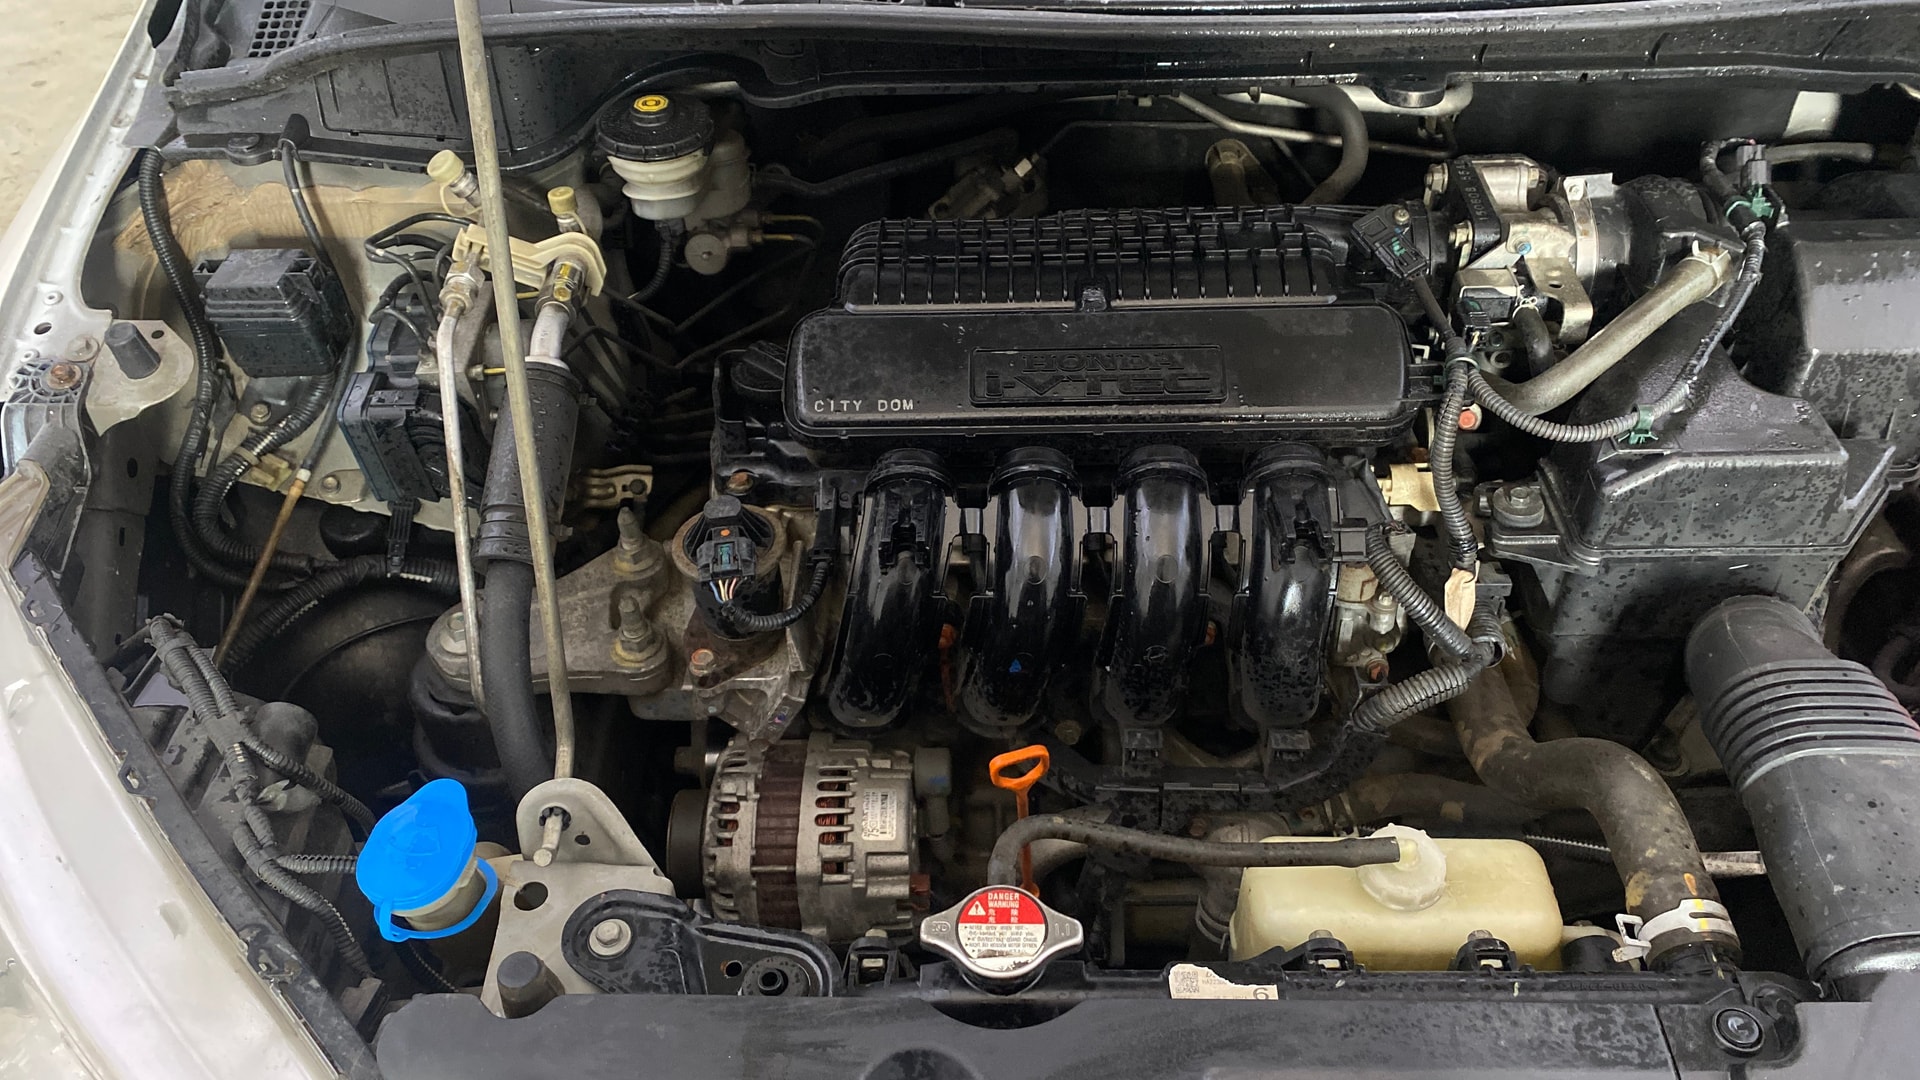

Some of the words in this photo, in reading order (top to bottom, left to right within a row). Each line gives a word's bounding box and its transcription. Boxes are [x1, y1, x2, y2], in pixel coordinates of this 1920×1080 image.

[1022, 353, 1184, 372] HONDA
[814, 400, 863, 413] CITY
[877, 399, 914, 412] DOM
[988, 892, 1020, 900] DANGER
[988, 900, 1020, 908] WARNUNG
